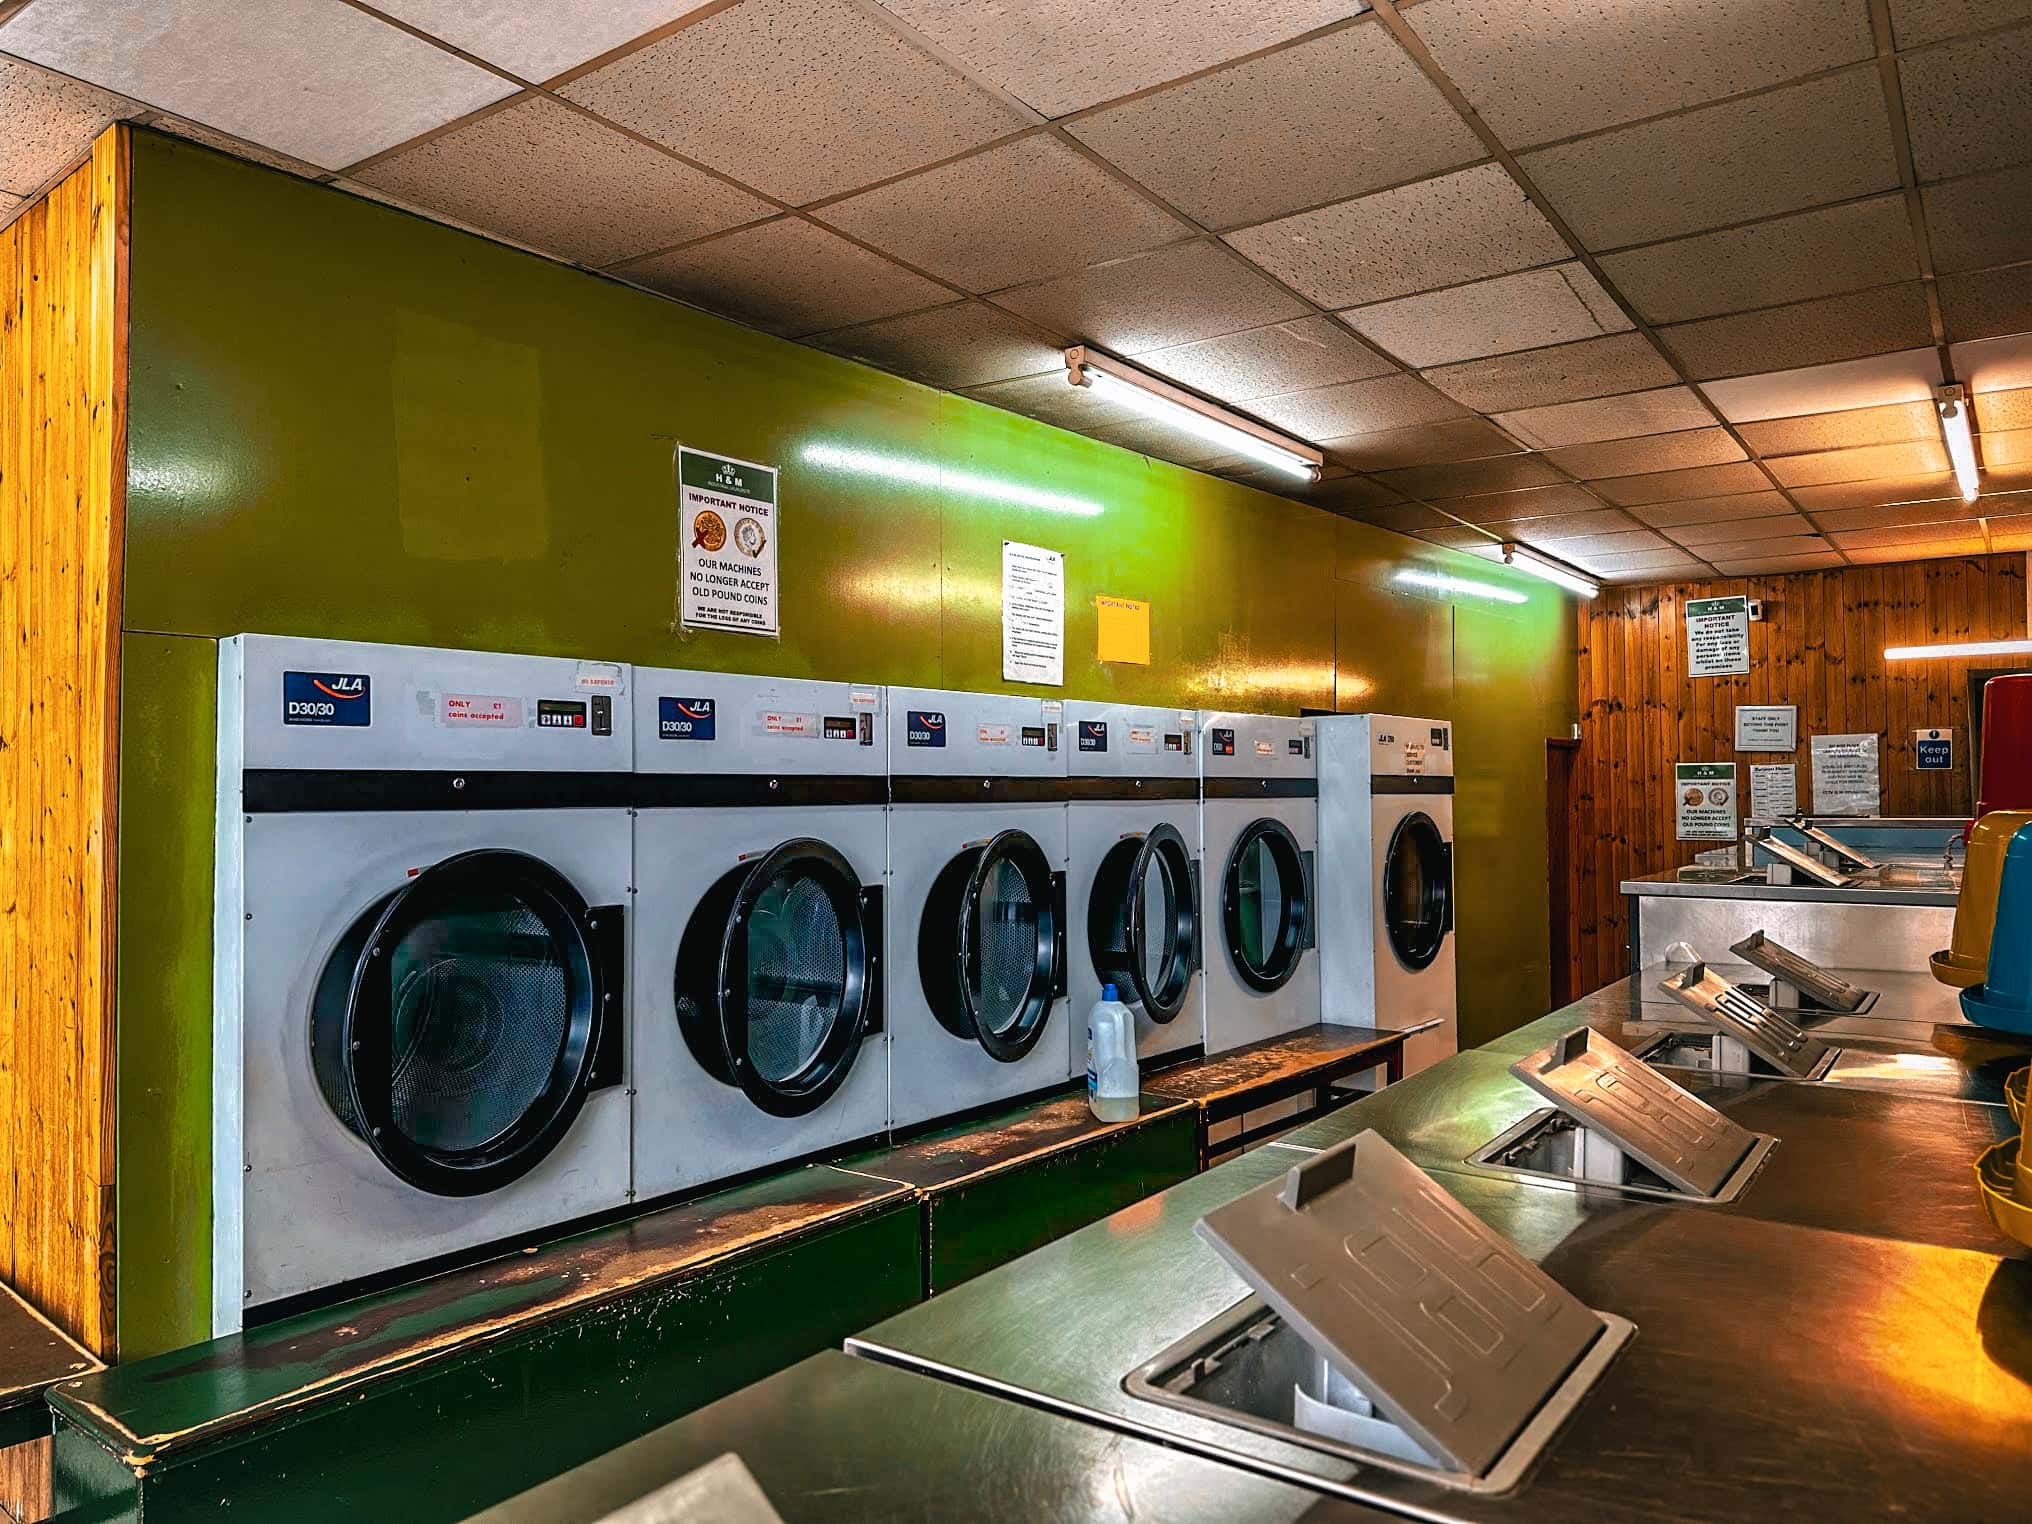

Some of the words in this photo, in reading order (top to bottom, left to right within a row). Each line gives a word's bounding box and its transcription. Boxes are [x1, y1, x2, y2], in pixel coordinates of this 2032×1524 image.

[715, 473, 723, 483] H
[725, 476, 732, 485] &
[735, 477, 743, 487] M
[689, 492, 737, 509] IMPORTANT
[739, 504, 769, 516] NOTICE
[698, 558, 717, 569] OUR
[720, 561, 762, 576] MACHINES
[690, 571, 703, 582] NO
[705, 573, 739, 588] LONGER
[740, 580, 770, 591] ACCEPT
[692, 586, 710, 597] OLD
[711, 589, 742, 602] POUND
[744, 594, 768, 606] COINS
[730, 610, 762, 619] RESPONSIBLE
[1696, 615, 1736, 623] IMPORTANT
[331, 677, 362, 691] JLA
[288, 702, 335, 716] D30/30
[448, 700, 471, 708] ONLY
[690, 701, 710, 712] JLA
[470, 712, 504, 720] accepted
[928, 714, 943, 723] JLA
[1920, 745, 1949, 755] Keep
[1925, 756, 1943, 764] out
